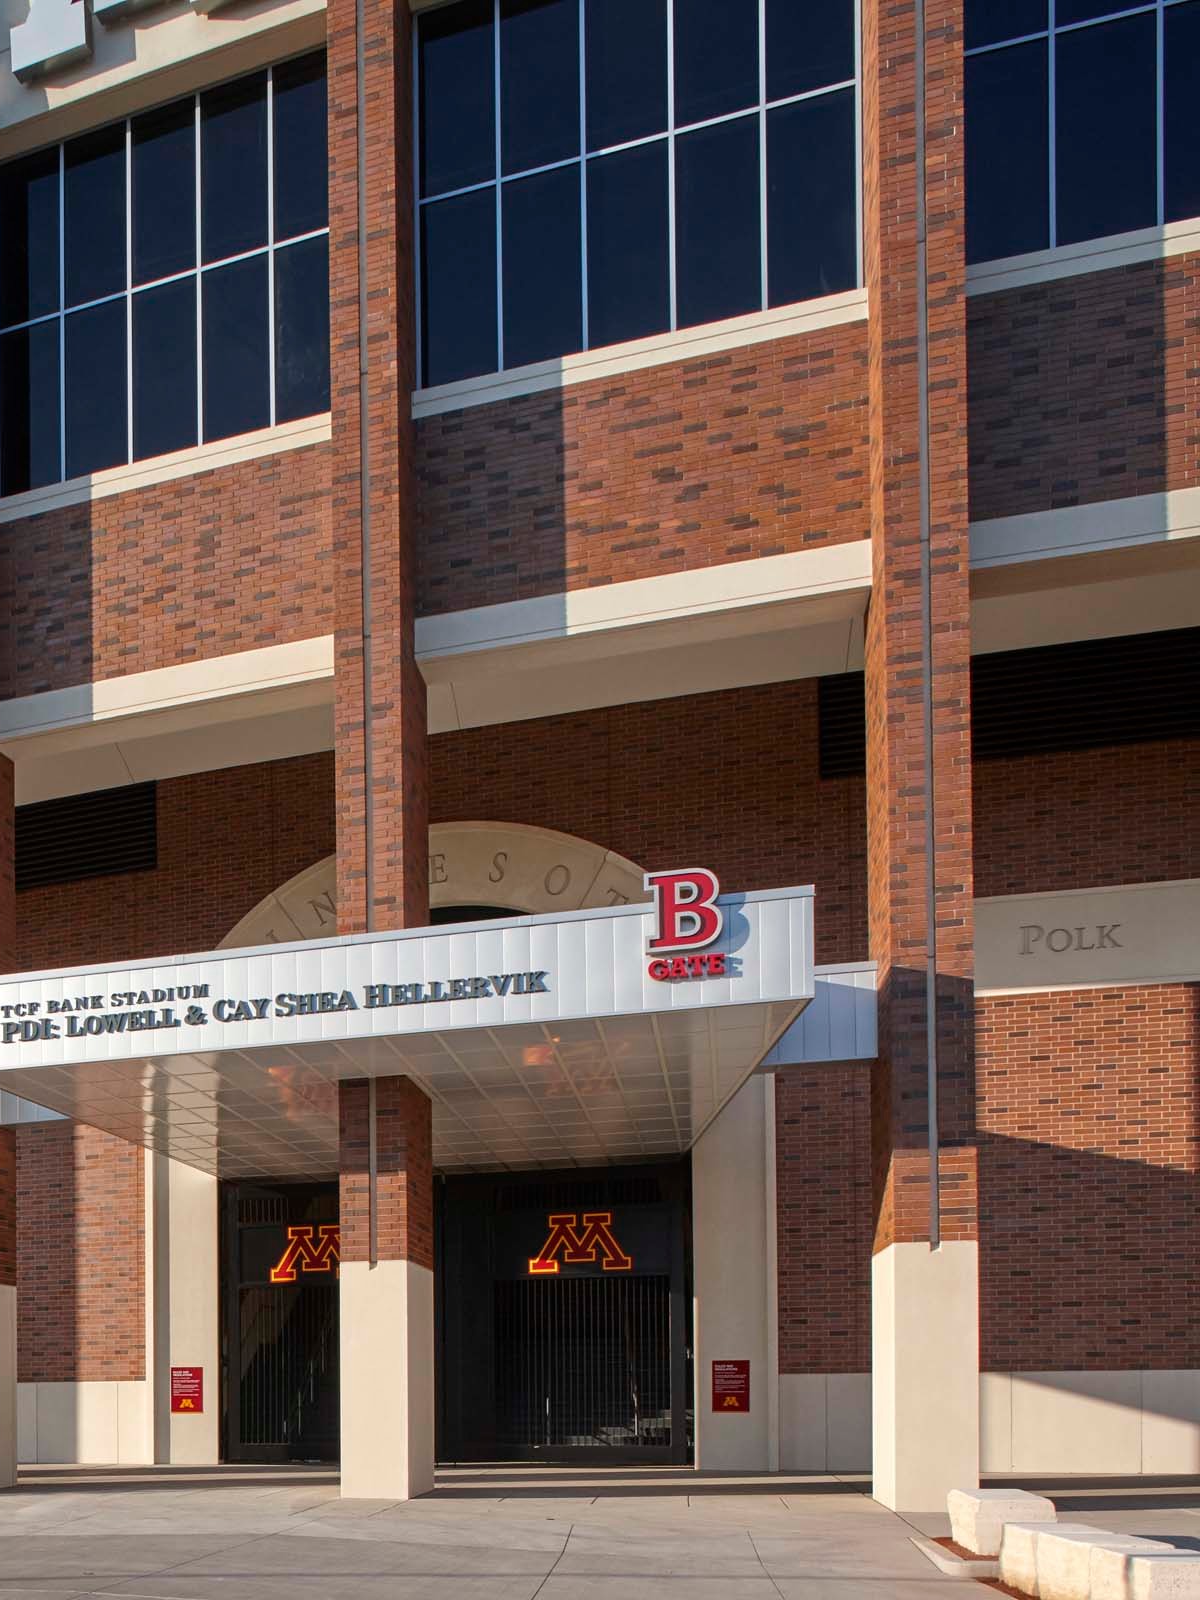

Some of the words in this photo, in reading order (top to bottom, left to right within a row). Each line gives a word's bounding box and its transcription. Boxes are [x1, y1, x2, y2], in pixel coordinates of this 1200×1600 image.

[643, 867, 723, 953] B
[1018, 923, 1125, 956] POLK
[647, 952, 726, 981] GATE
[0, 1001, 42, 1018] TCF
[46, 995, 105, 1013] BANK
[110, 983, 210, 1007] STADIUM
[65, 1008, 181, 1037] LOWELL
[184, 1004, 209, 1025] &
[212, 999, 272, 1022] CAY
[275, 990, 360, 1018] SHEA
[363, 970, 552, 1009] HELLERVIK
[528, 1212, 632, 1274] M
